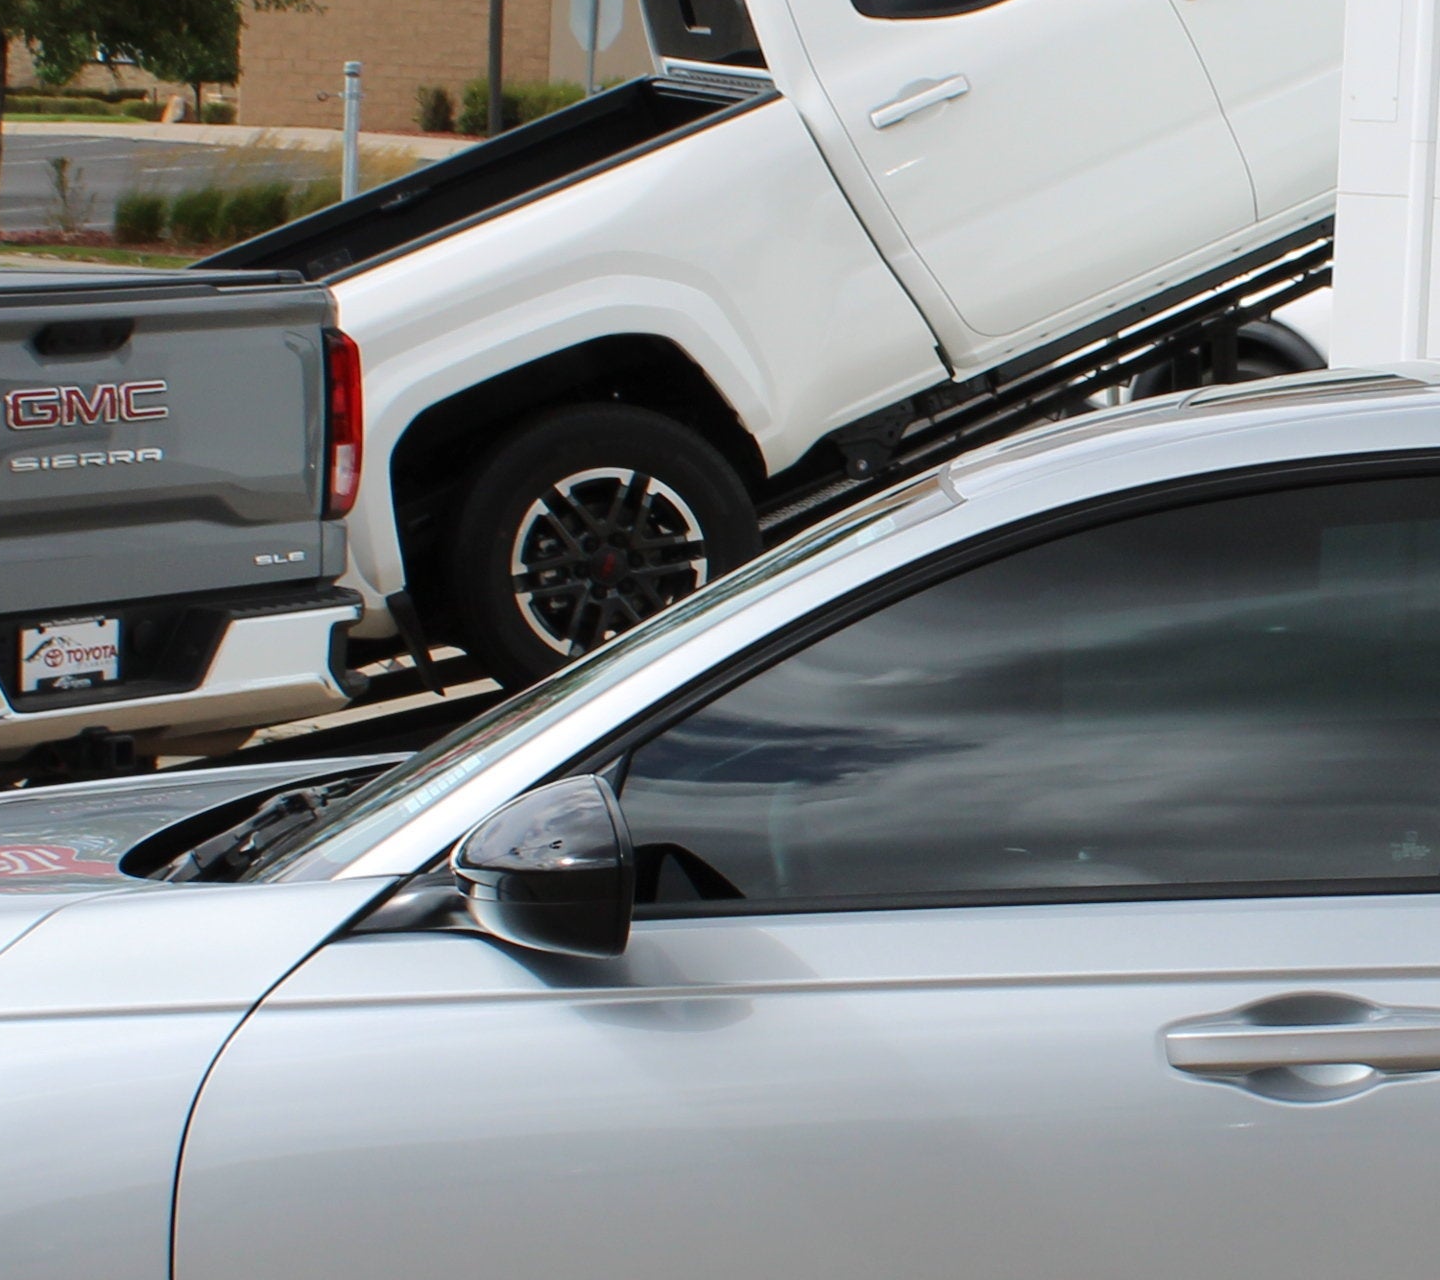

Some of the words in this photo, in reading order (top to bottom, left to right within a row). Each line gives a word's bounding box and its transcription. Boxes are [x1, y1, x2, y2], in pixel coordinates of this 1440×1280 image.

[5, 380, 169, 430] GMC
[11, 447, 164, 472] SIERRA
[254, 550, 307, 566] SLE
[66, 644, 118, 664] TOYOTA
